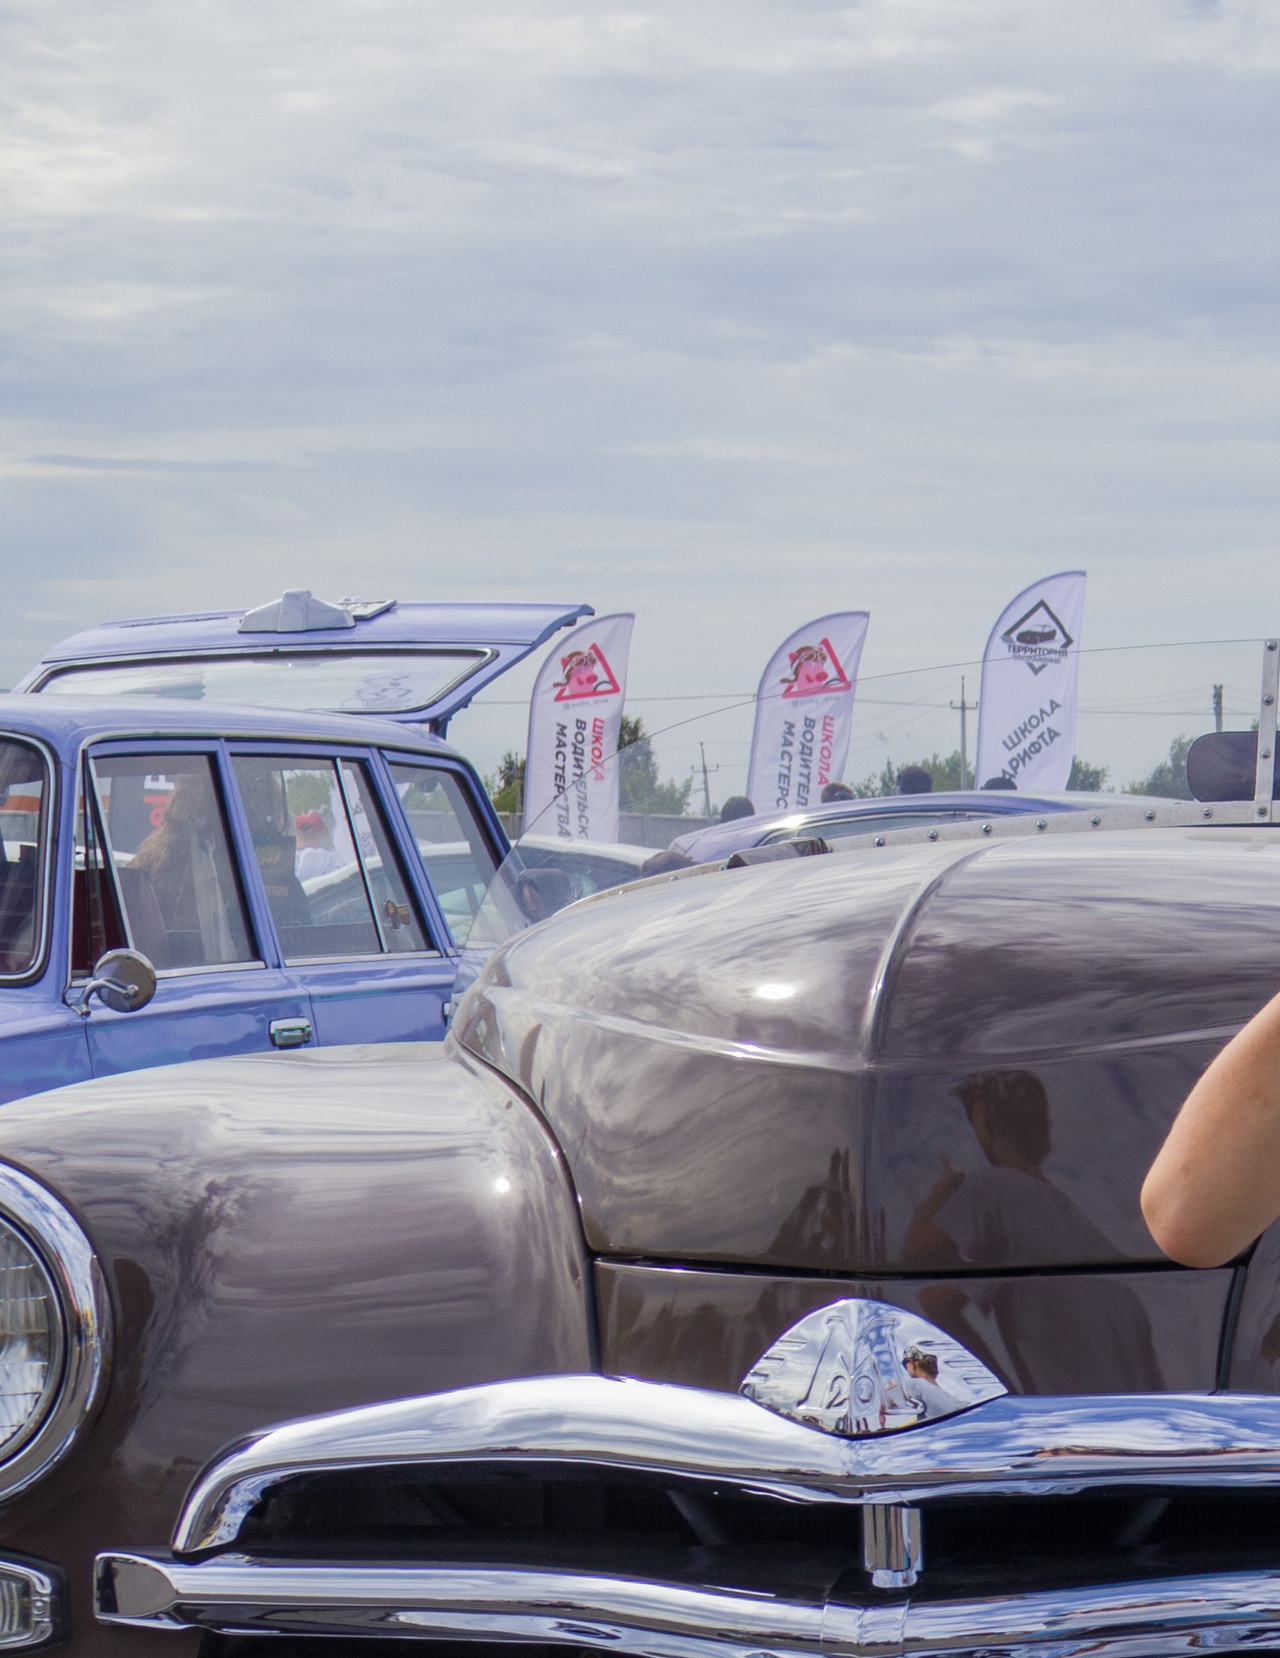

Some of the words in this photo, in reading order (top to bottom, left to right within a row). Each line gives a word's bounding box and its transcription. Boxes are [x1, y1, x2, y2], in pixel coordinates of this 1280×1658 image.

[591, 717, 605, 782] ШКОЛА
[817, 714, 835, 786] ШКОЛА
[1002, 698, 1062, 751] ШКОЛА
